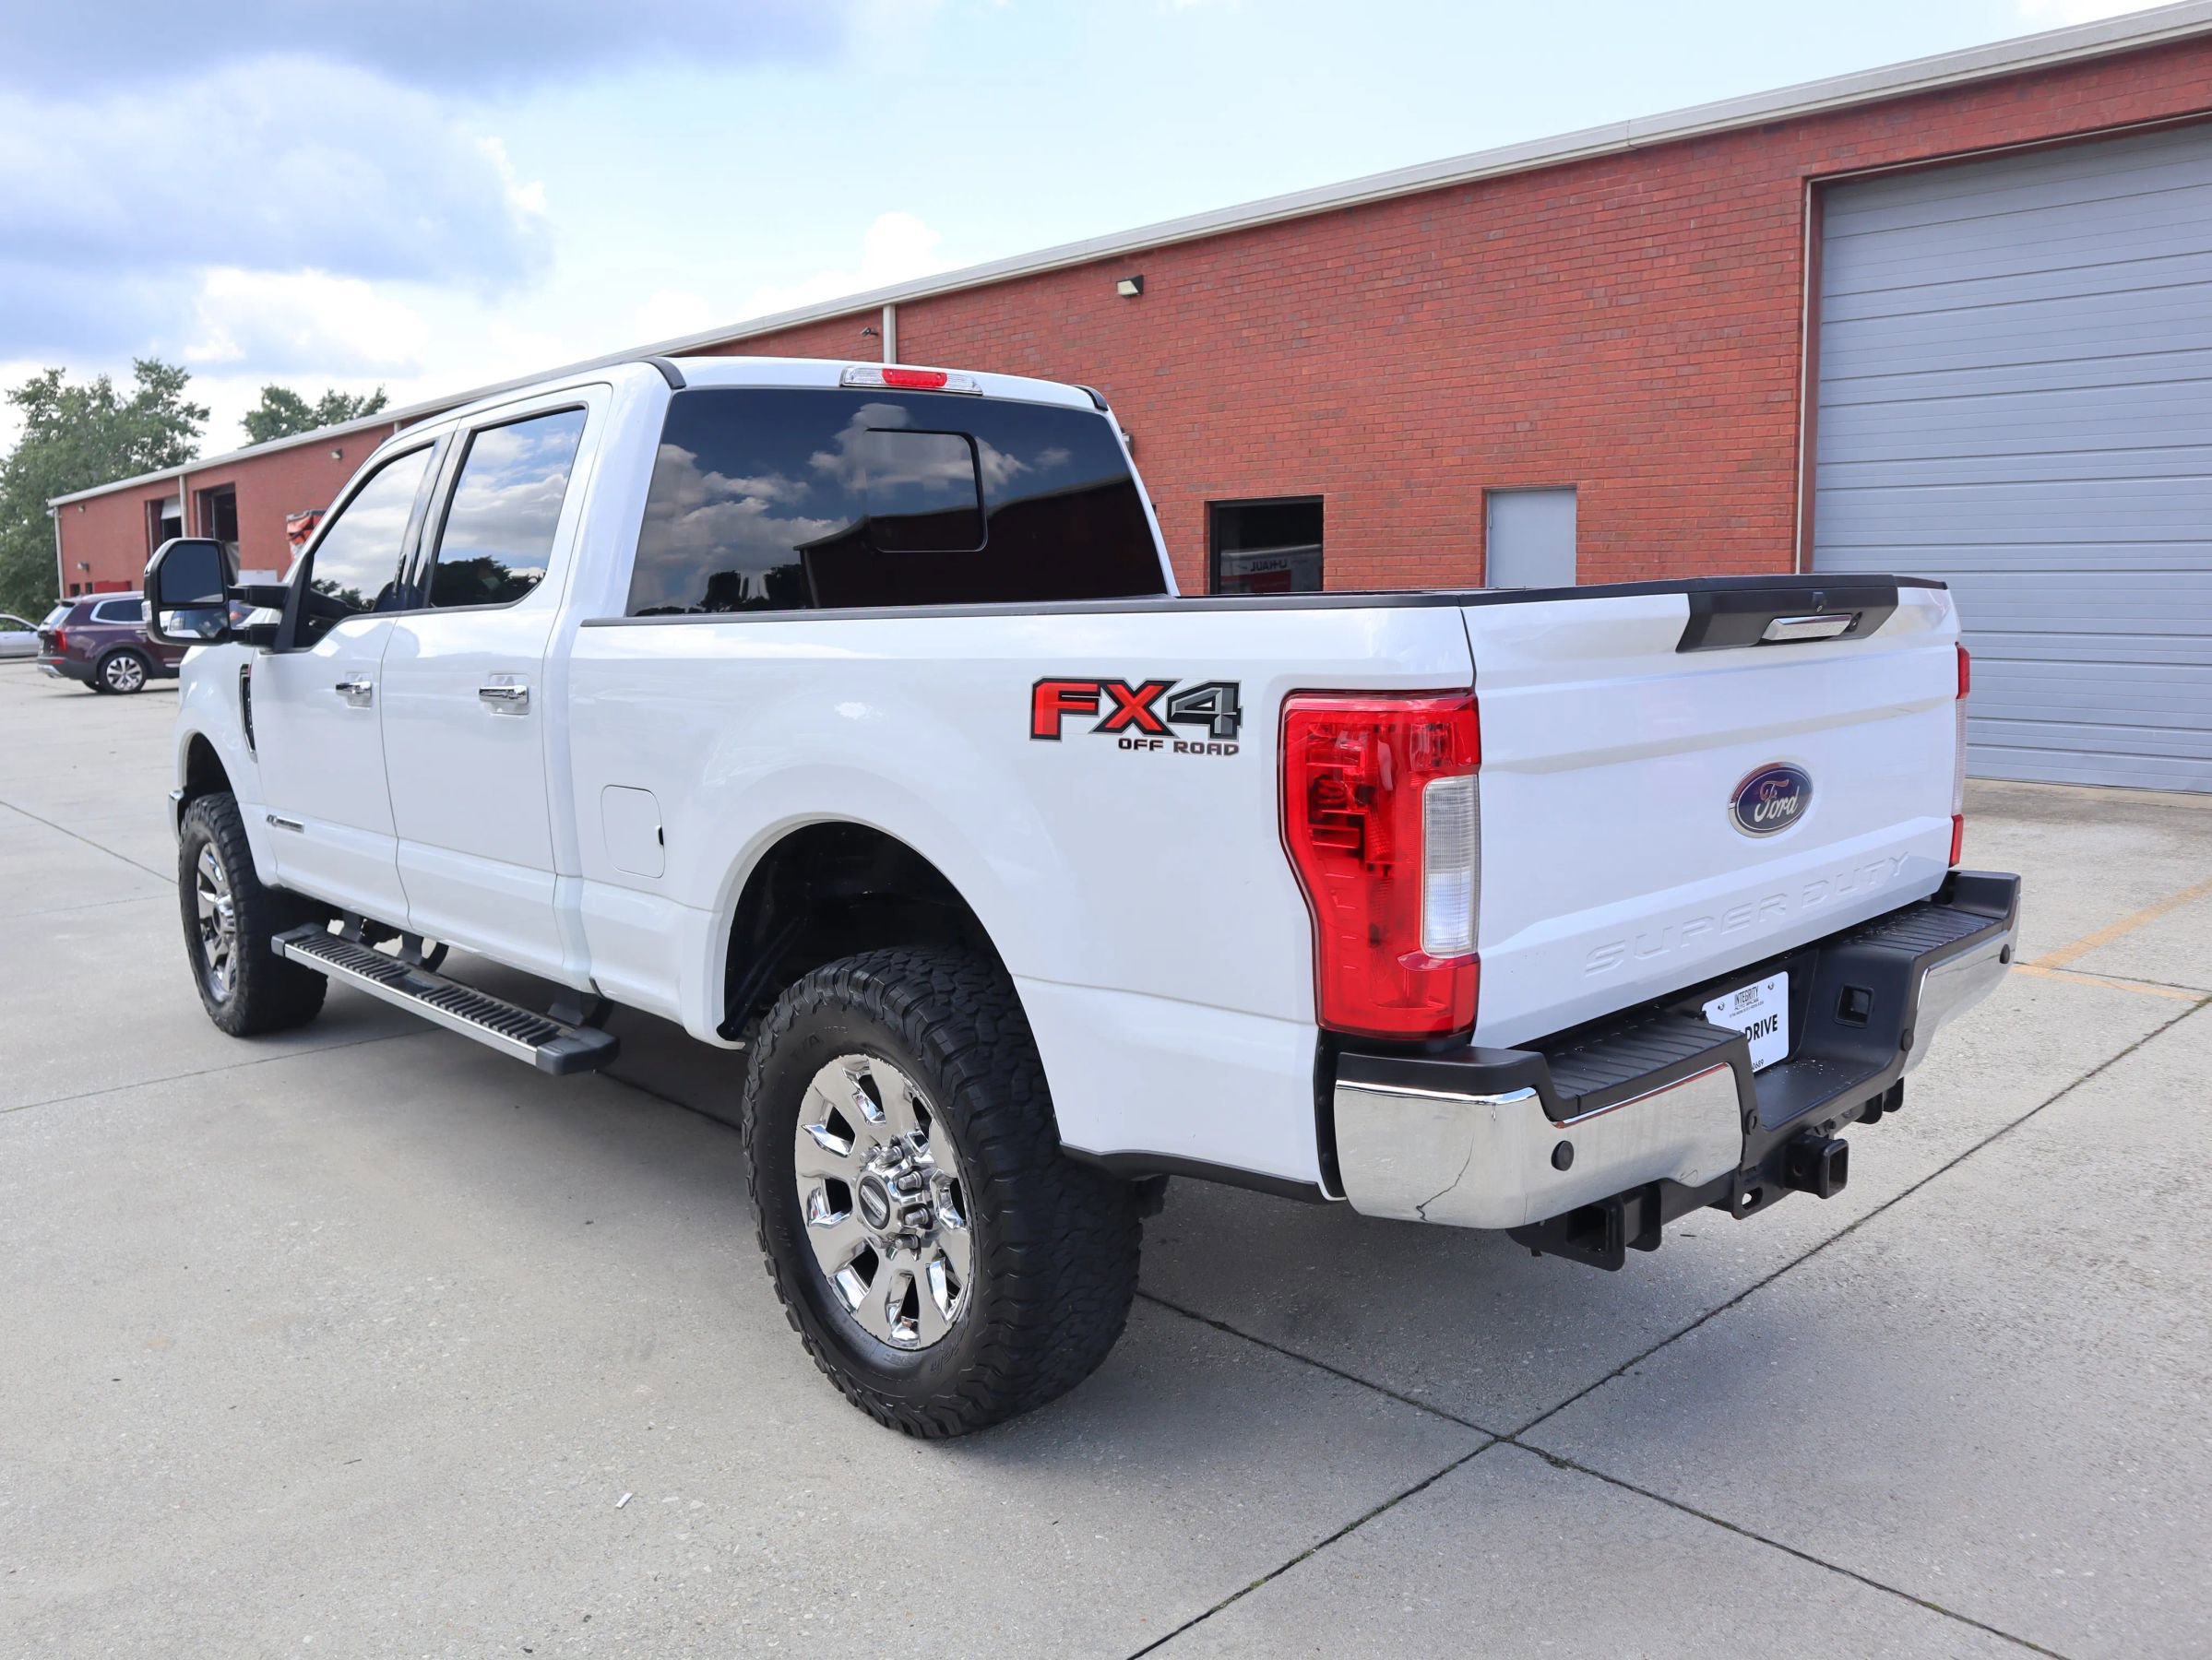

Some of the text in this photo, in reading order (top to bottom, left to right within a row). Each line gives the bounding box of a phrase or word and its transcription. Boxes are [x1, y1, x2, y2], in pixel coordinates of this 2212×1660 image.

[1029, 677, 1243, 741] FX4
[1118, 738, 1239, 755] OFF ROAD
[1754, 778, 1800, 822] Ford
[1585, 852, 1909, 978] SUPER DUTY
[1734, 986, 1759, 1005] INTEGRITY
[1744, 1014, 1778, 1043] DRIVE
